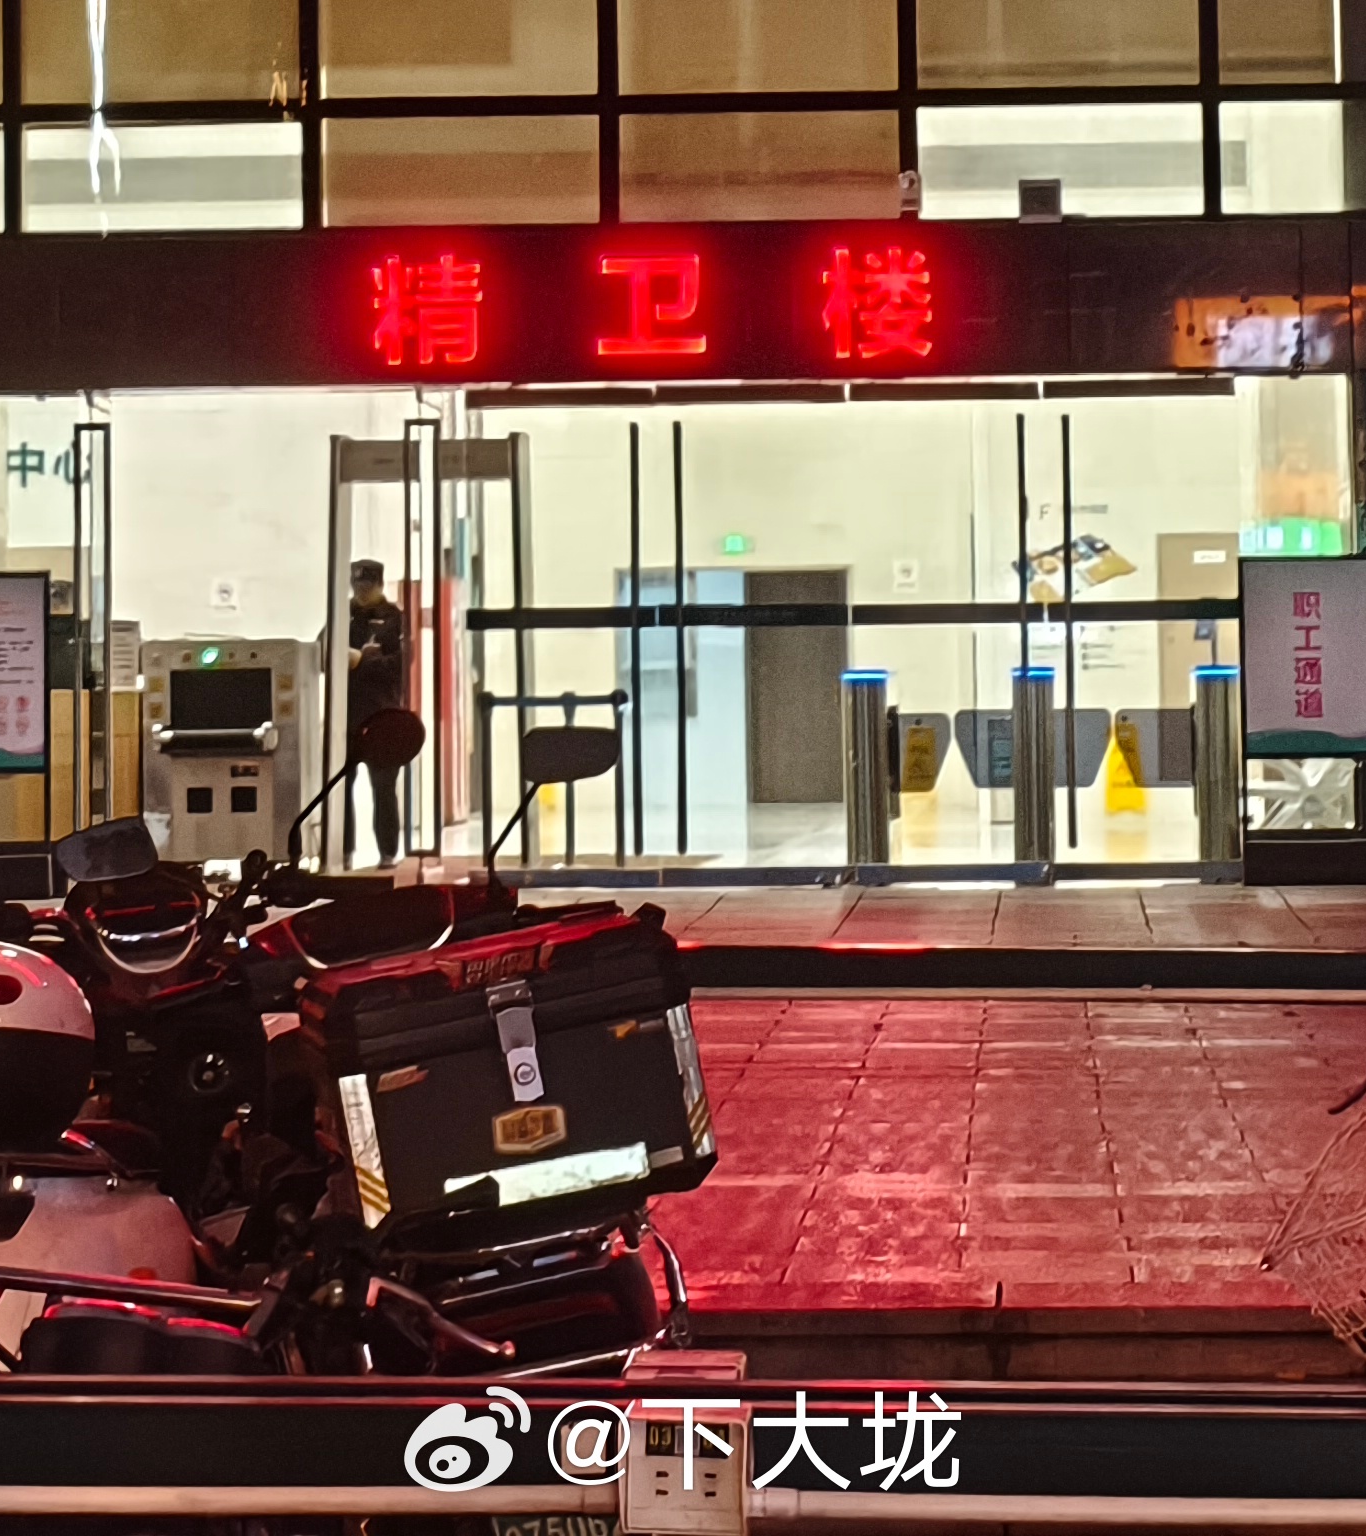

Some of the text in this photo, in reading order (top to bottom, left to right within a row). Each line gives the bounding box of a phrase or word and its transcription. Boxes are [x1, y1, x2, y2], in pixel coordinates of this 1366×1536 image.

[372, 247, 933, 366] 精卫楼
[1292, 591, 1324, 719] 职工通道
